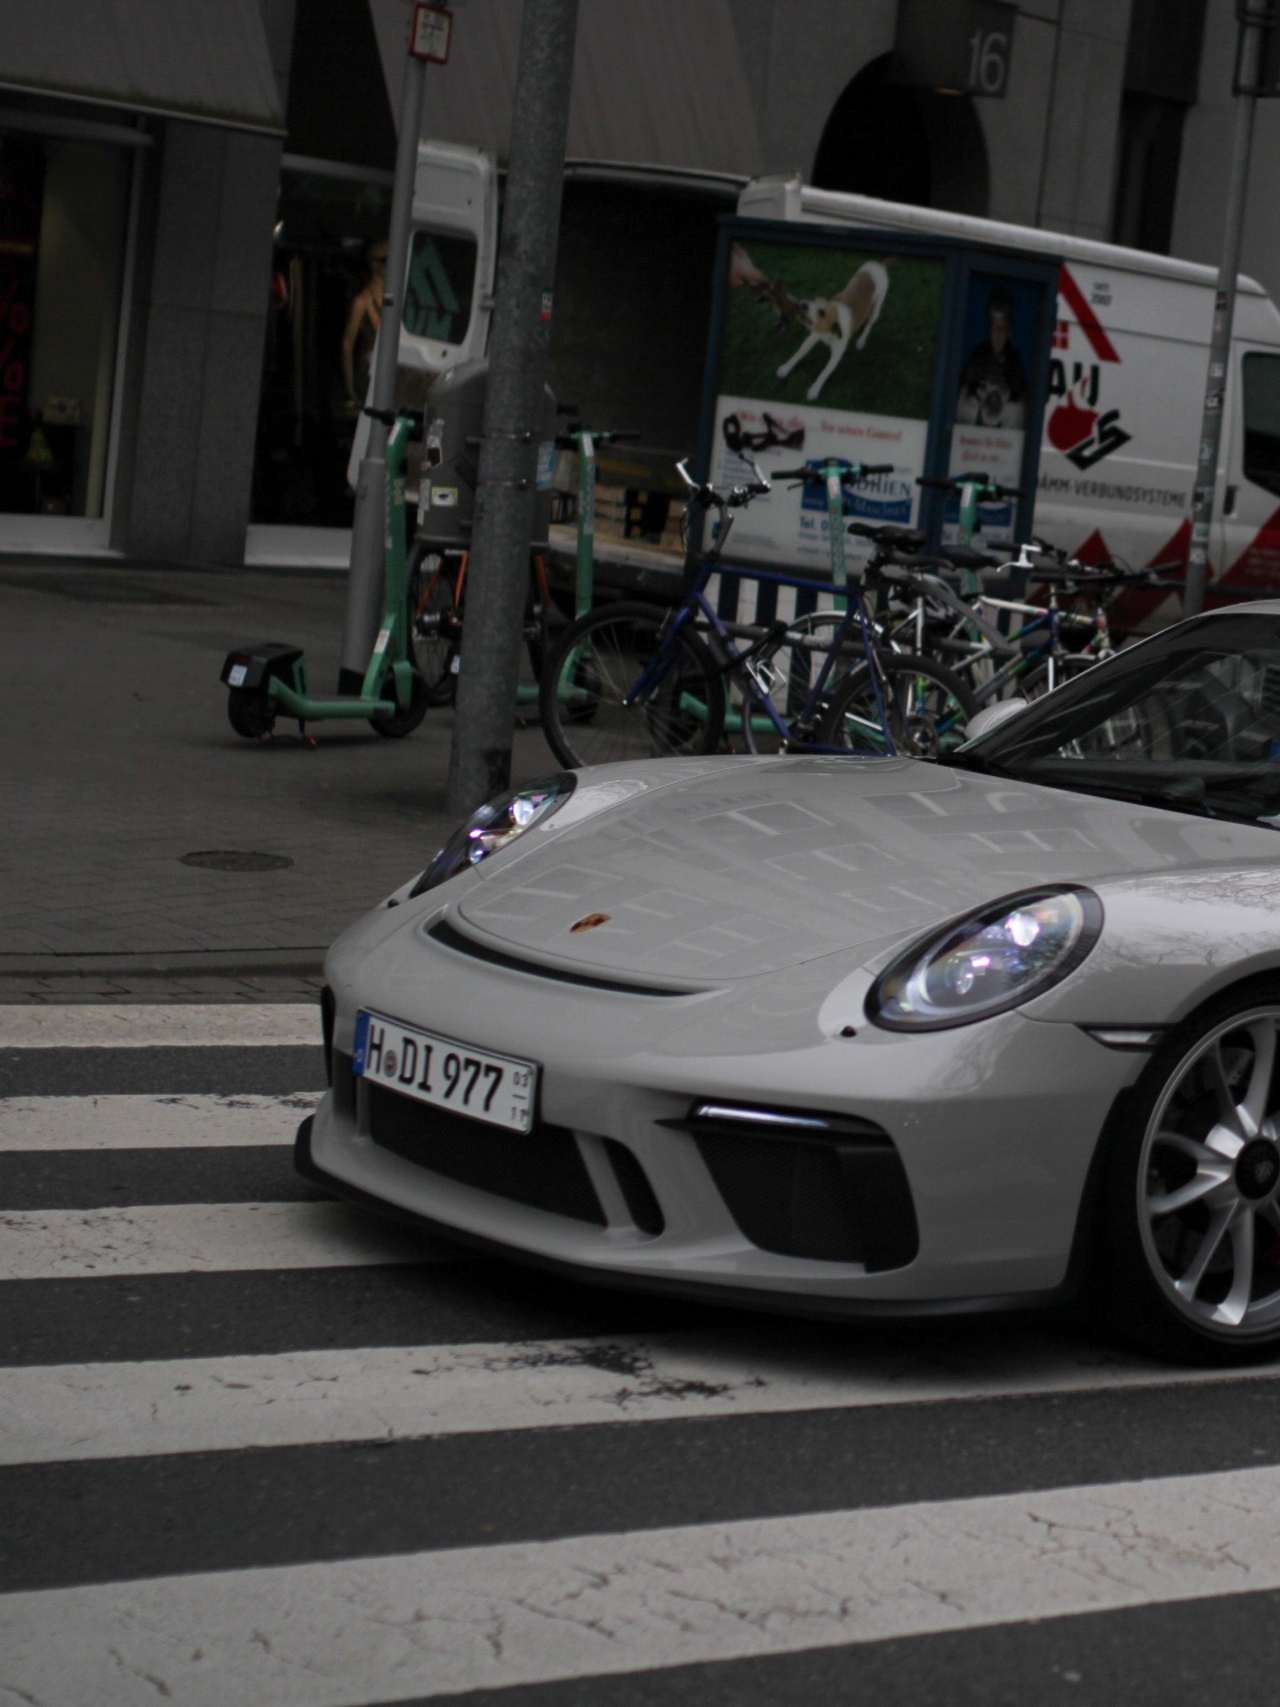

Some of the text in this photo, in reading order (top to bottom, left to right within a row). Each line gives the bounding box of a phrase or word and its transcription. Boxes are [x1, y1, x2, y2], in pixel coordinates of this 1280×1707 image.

[968, 26, 1008, 91] 16
[366, 1024, 385, 1074] H
[398, 1036, 434, 1092] DI
[443, 1053, 503, 1112] 977
